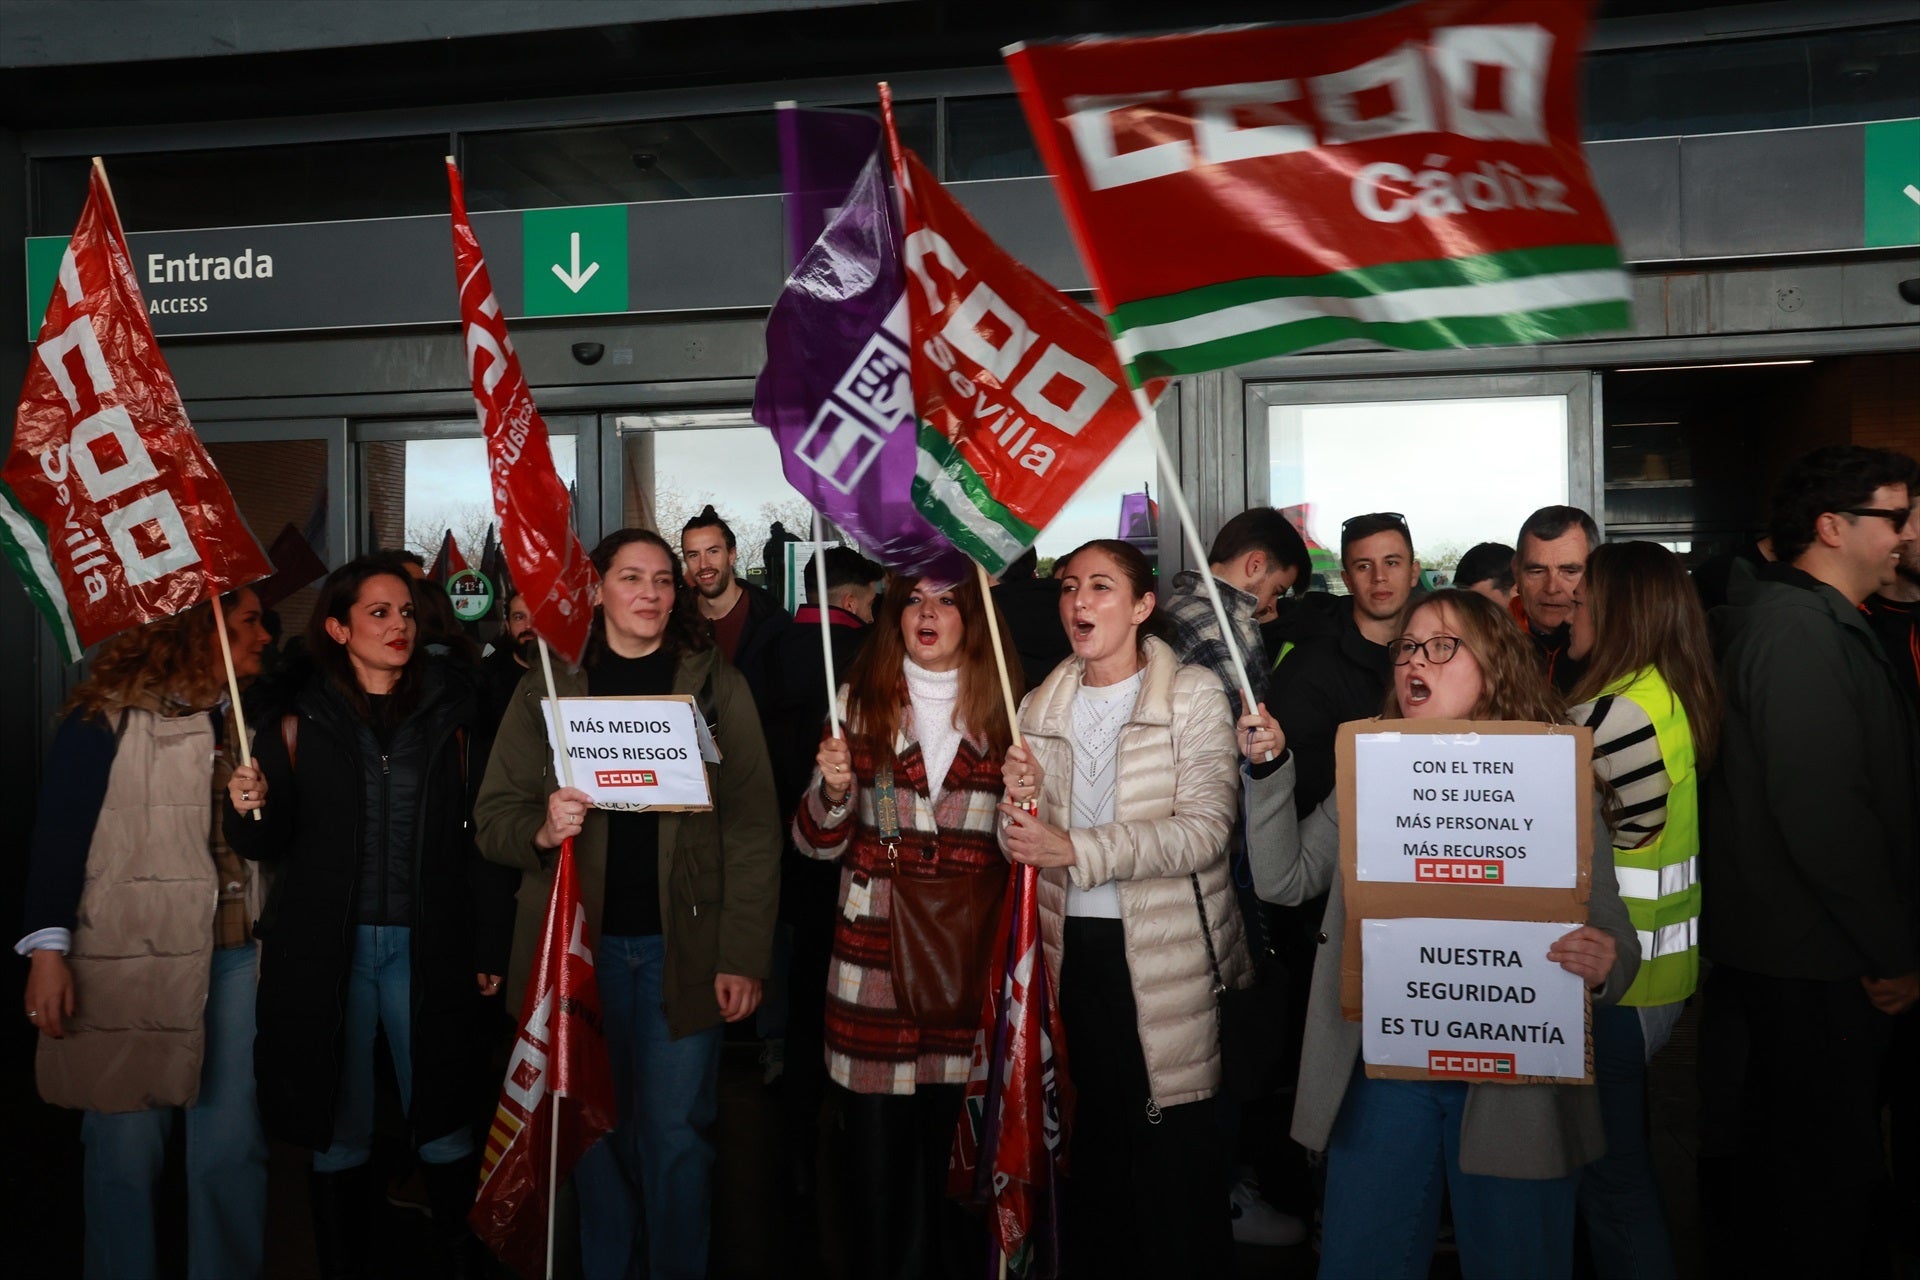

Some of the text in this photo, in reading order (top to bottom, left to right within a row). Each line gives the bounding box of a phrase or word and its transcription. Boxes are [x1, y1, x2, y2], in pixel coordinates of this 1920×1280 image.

[1352, 153, 1578, 223] Cádiz
[148, 248, 273, 283] Entrada
[149, 297, 208, 314] ACCESS
[570, 717, 671, 734] MÁS MEDIOS
[623, 747, 688, 760] RIESGOS
[1412, 760, 1514, 775] CON EL TREN
[1413, 788, 1515, 803] NO SE JUEGA
[1396, 812, 1535, 831] MÁS PERSONAL Y
[1403, 841, 1527, 859] MÁS RECURSOS
[1420, 946, 1523, 968] NUESTRA
[1406, 981, 1537, 1004] SEGURIDAD
[1381, 1017, 1565, 1045] ES TU GARANTÍA
